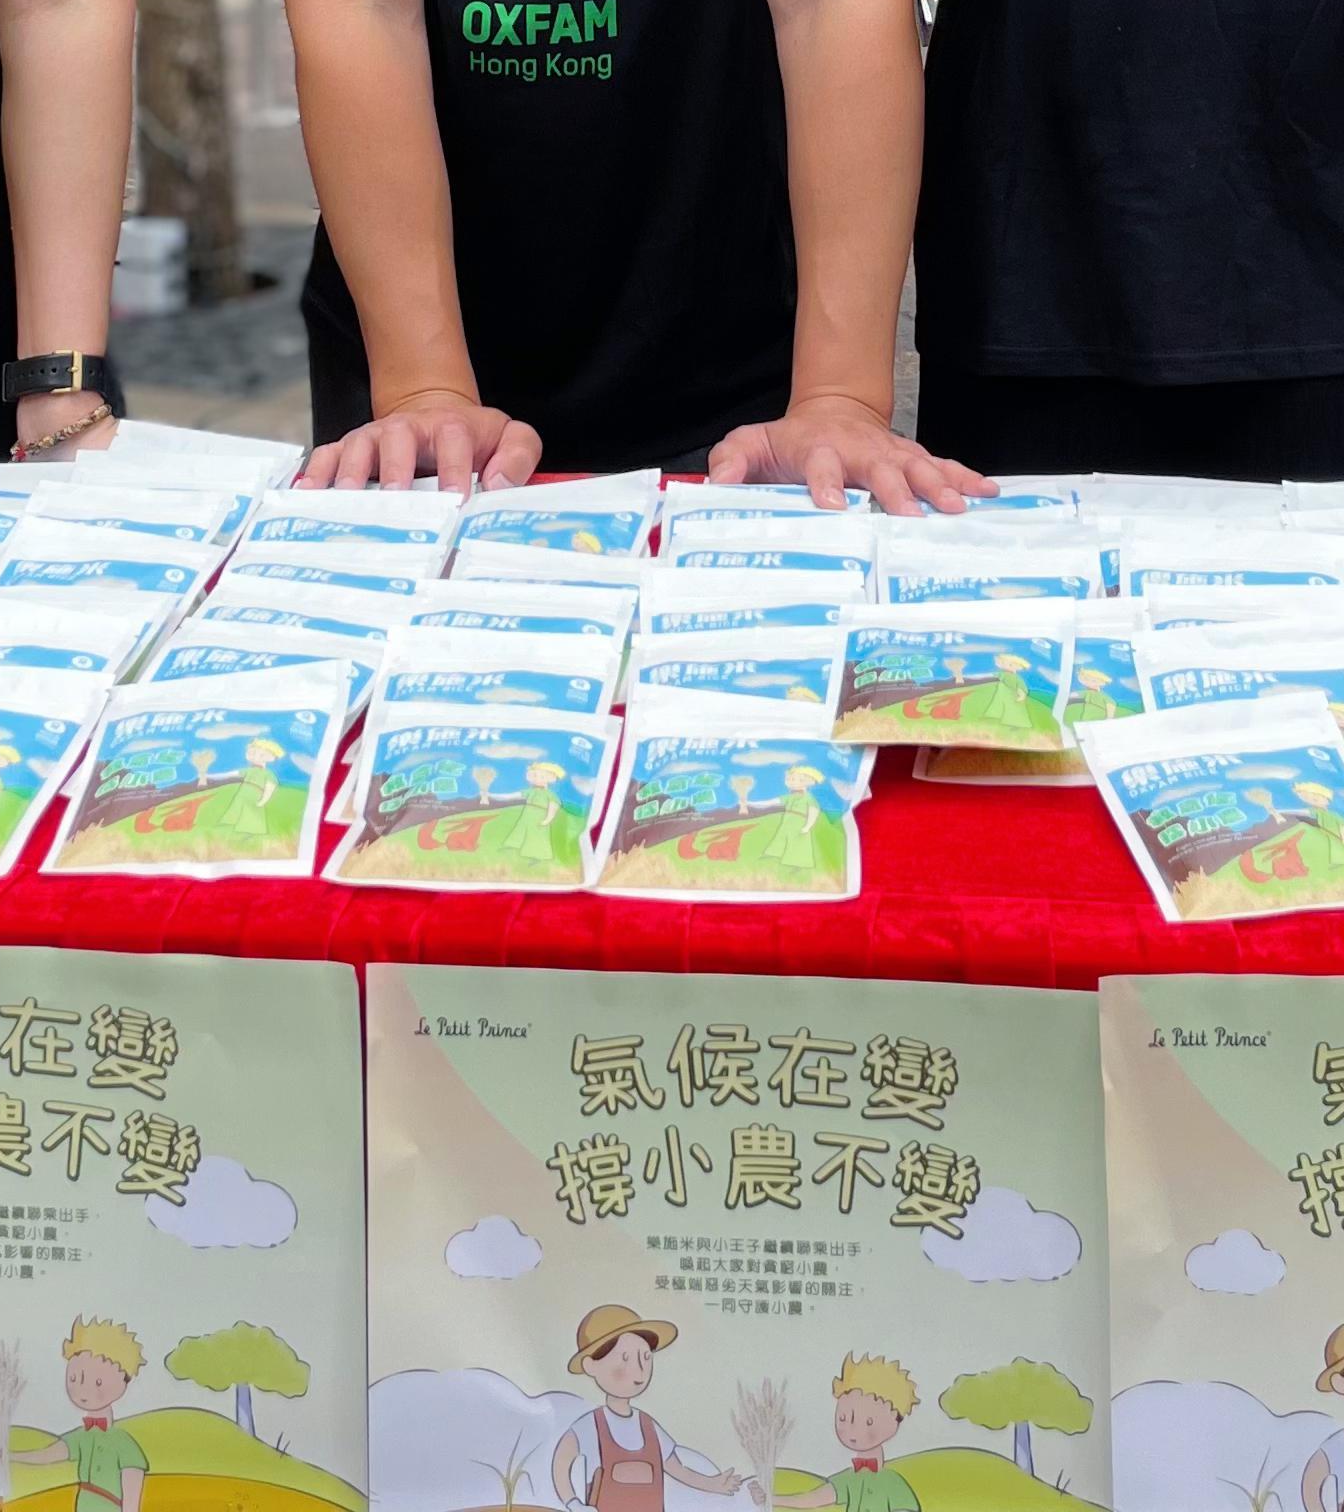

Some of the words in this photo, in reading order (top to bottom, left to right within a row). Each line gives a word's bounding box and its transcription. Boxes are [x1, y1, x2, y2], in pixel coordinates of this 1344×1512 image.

[469, 51, 537, 82] Hong
[545, 51, 613, 80] Kong
[415, 1016, 430, 1036] Le
[437, 1016, 471, 1039] Petit
[477, 1017, 532, 1039] Prince
[1148, 1027, 1165, 1048] Le
[1172, 1026, 1209, 1047] Petit
[1215, 1027, 1271, 1048] Prince
[570, 1023, 959, 1131] 氣候在變
[546, 1123, 981, 1241] 撐小農不變
